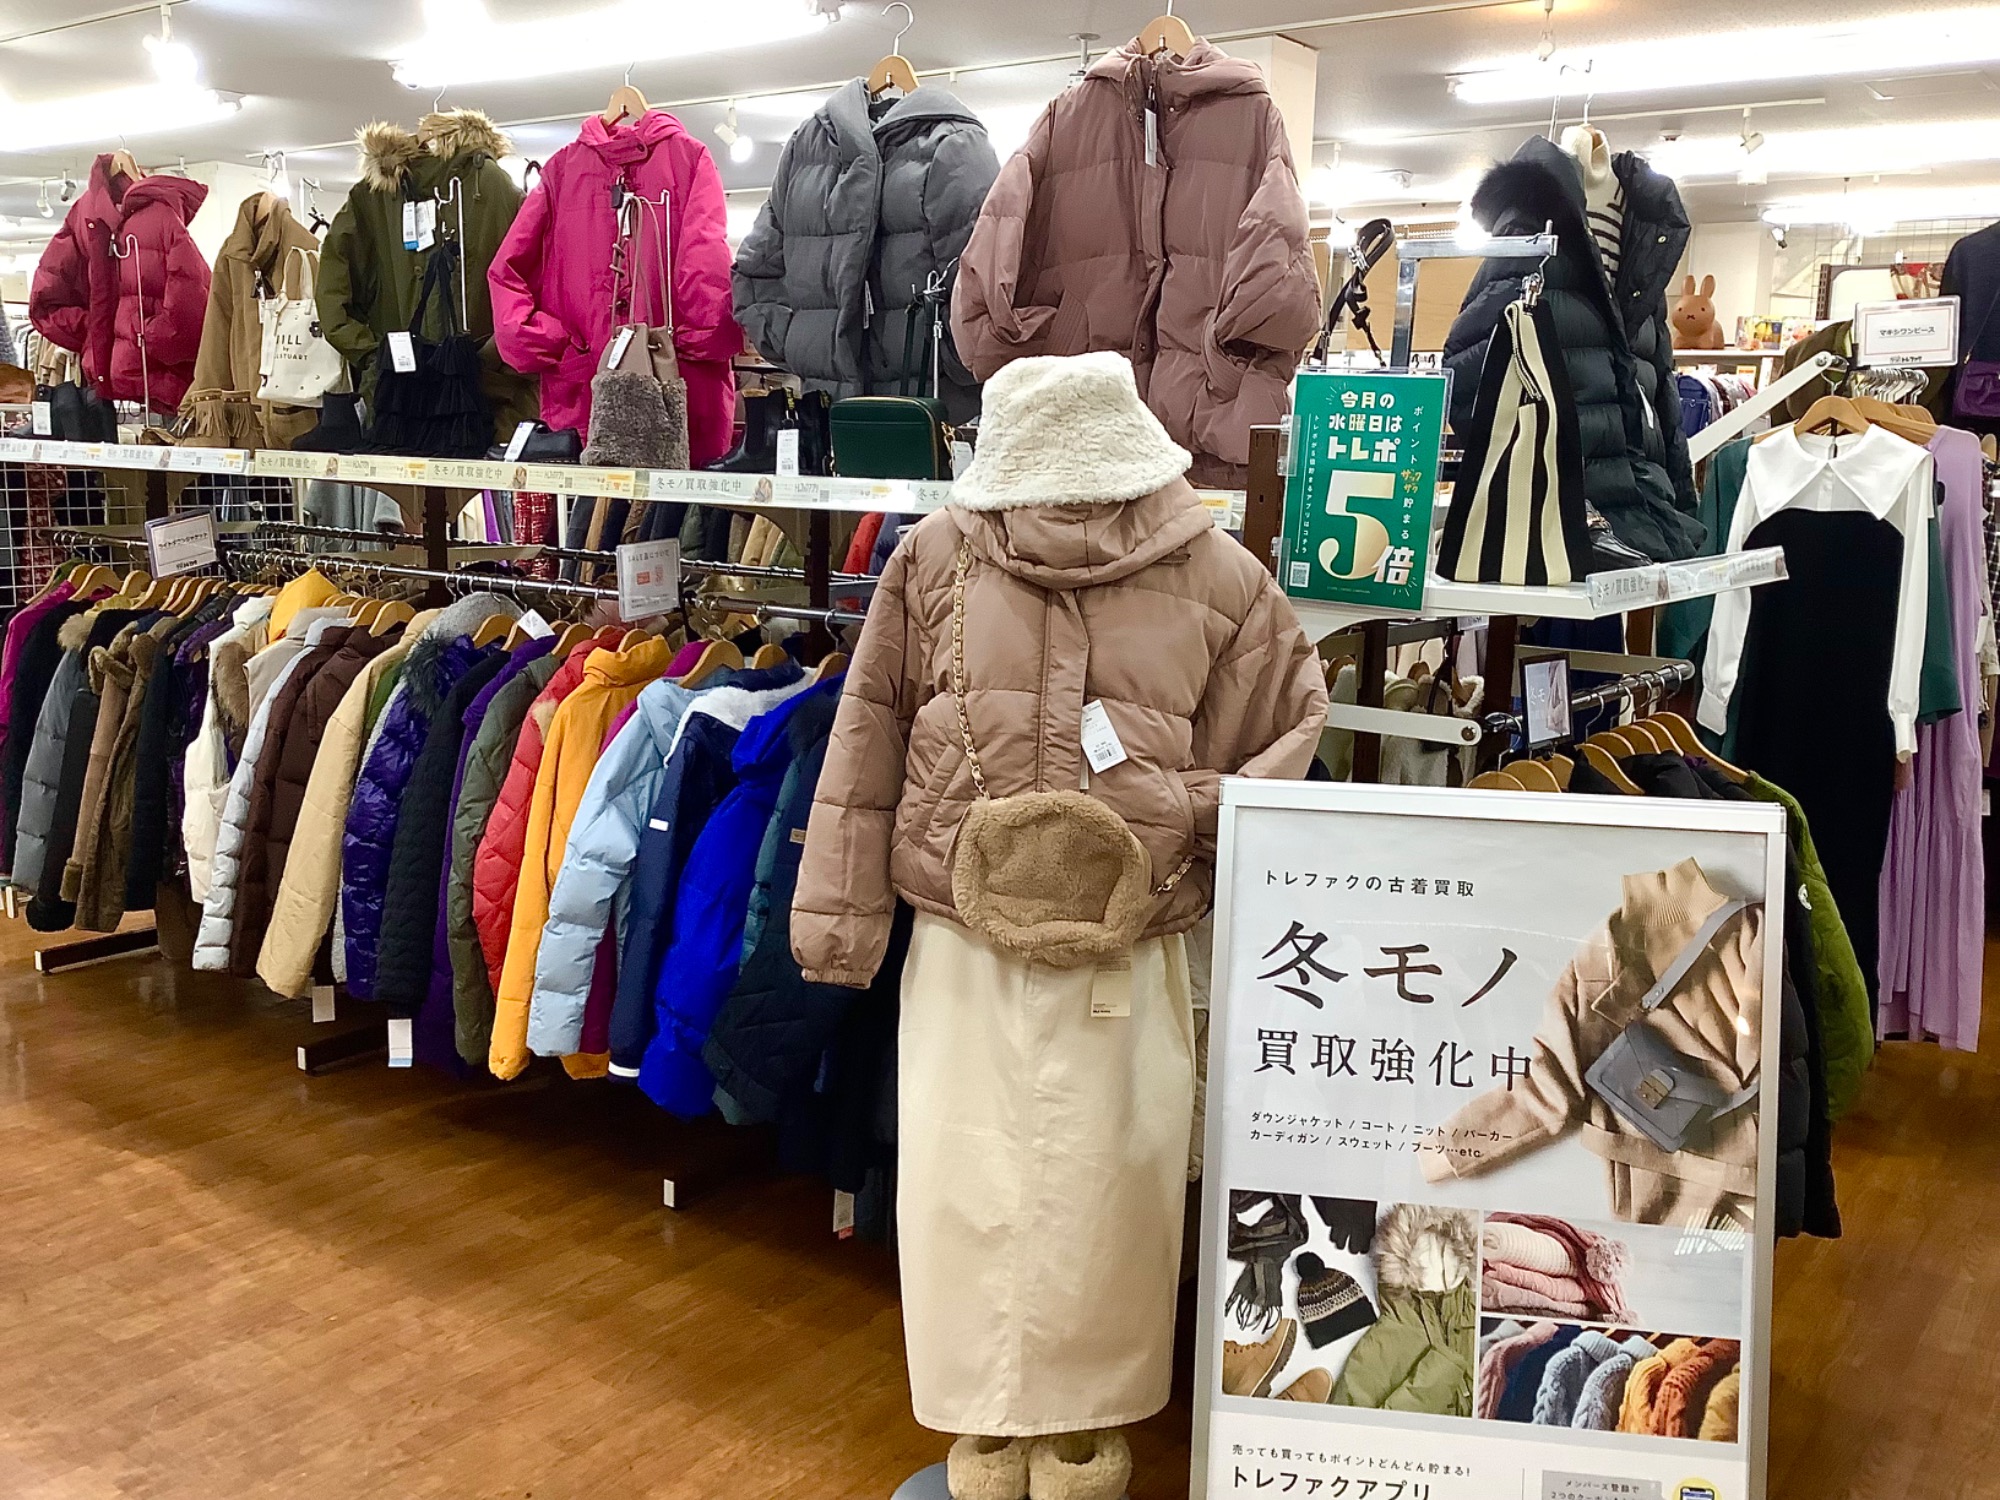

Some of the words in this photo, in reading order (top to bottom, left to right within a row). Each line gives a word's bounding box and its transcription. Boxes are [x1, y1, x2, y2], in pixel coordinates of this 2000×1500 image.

[1880, 326, 1935, 336] マキシワンピース
[1341, 391, 1395, 409] 今月の
[1328, 413, 1403, 433] 水曜日は
[1327, 436, 1401, 463] トレポ
[656, 476, 742, 493] 冬モノ買取強化中
[1266, 870, 1475, 897] トレファクの古着買取
[1256, 920, 1518, 1010] 冬モノ
[1253, 1027, 1533, 1092] 買取強化中
[1251, 1111, 1343, 1129] ダウンジャケット
[1362, 1120, 1394, 1133] コート
[1413, 1125, 1446, 1137] ニット
[1250, 1129, 1320, 1145] カーディガン
[1338, 1136, 1393, 1151] スウェット
[1234, 1465, 1430, 1500] トレファクアプリ
